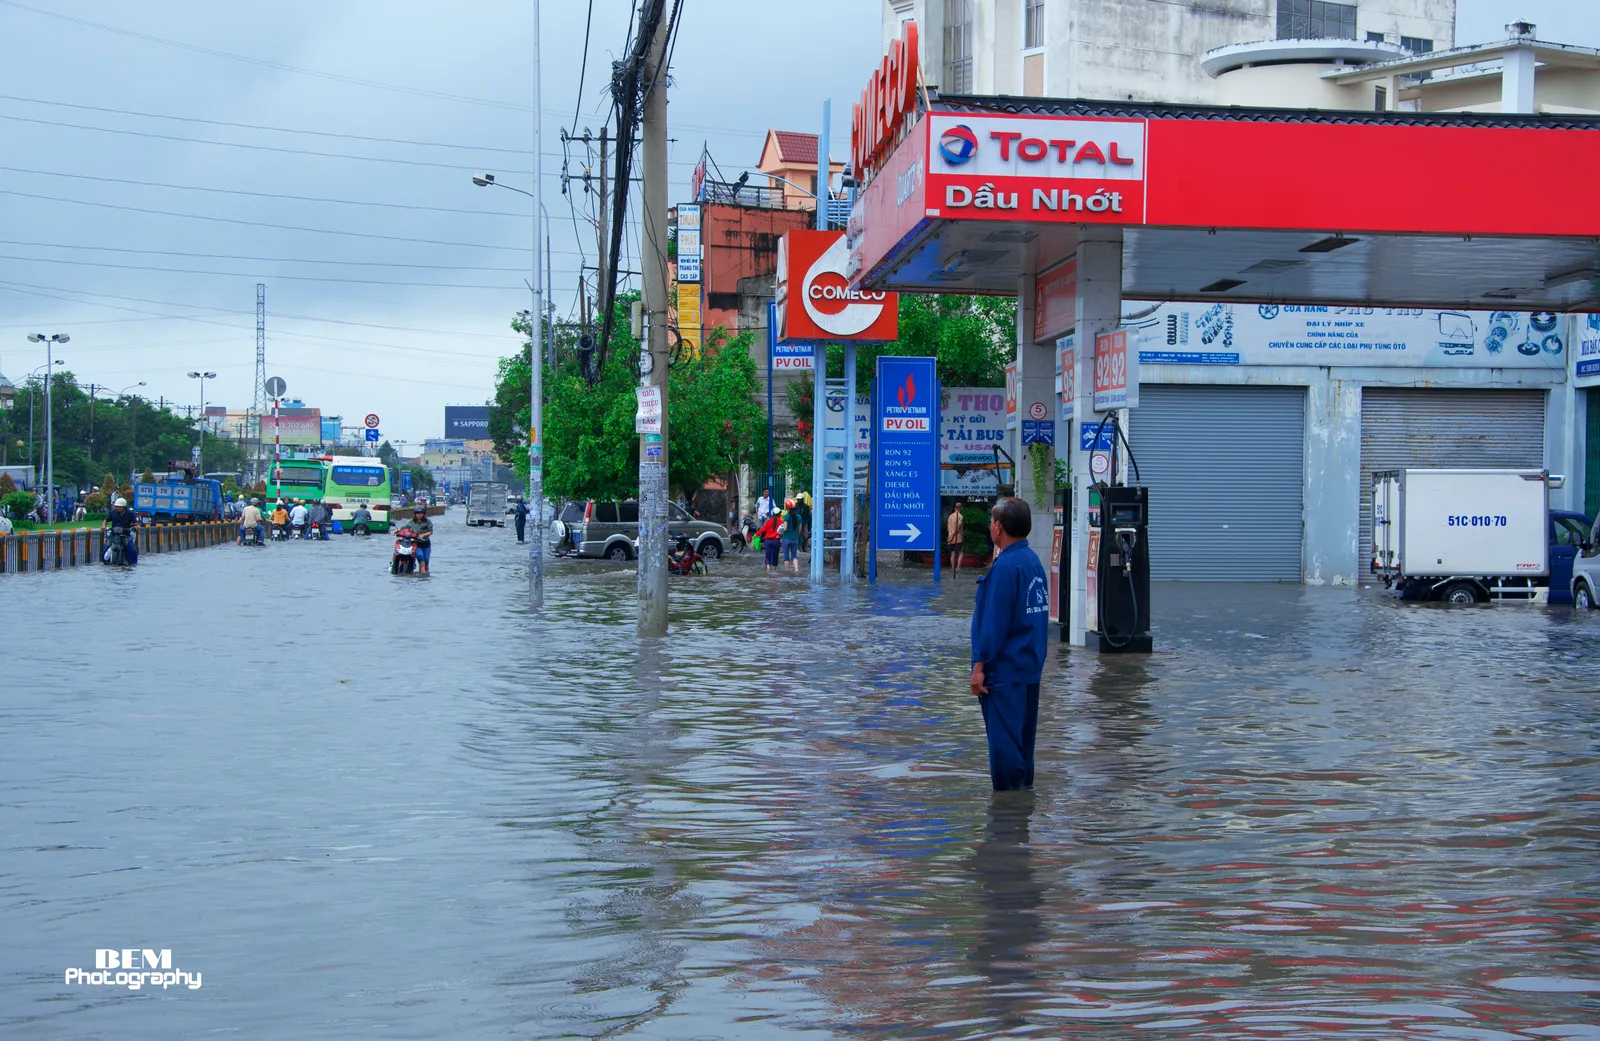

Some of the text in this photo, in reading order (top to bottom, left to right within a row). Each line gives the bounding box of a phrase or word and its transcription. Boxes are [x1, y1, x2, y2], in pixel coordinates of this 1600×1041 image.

[990, 131, 1133, 165] TOTAL
[945, 182, 1123, 212] Dầu Nhớt
[1328, 341, 1342, 349] CÁC
[1343, 342, 1358, 350] LOẠI
[776, 358, 812, 368] PV OIL
[1112, 352, 1125, 387] 92
[1097, 354, 1110, 388] 92
[1063, 369, 1074, 402] 95
[854, 395, 870, 405] ỬA
[958, 394, 1004, 415] THỌ
[886, 406, 927, 414] PETROVIETNAM
[854, 414, 867, 422] UA
[886, 419, 927, 430] PV OIL
[953, 414, 966, 423] KÝ
[946, 425, 1004, 441] TẢI BUS
